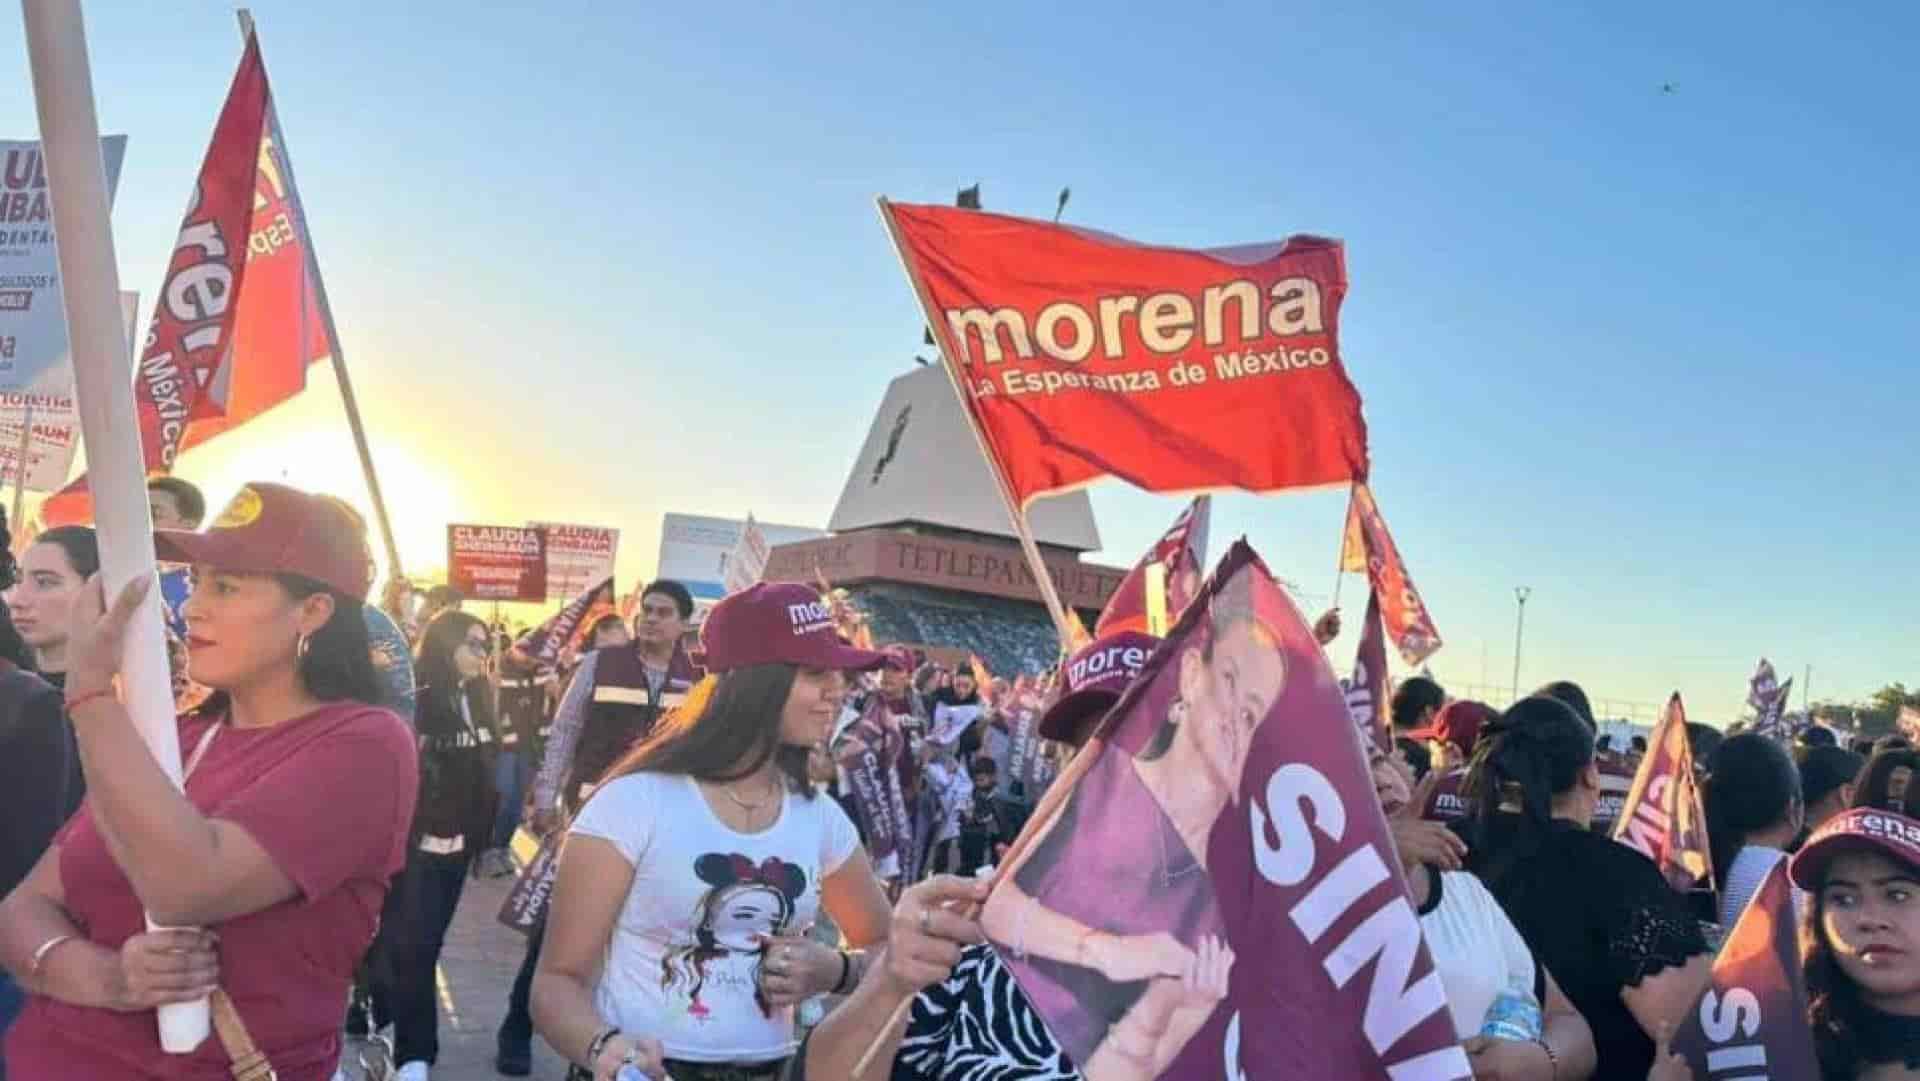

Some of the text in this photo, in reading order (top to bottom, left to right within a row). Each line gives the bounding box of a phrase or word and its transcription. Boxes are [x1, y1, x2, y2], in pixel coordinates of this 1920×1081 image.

[946, 274, 1328, 364] morena
[968, 345, 1330, 399] La Esperanza de México
[453, 526, 539, 543] CLAUDIA
[1068, 646, 1154, 688] more
[1828, 814, 1920, 842] orena
[1700, 987, 1768, 1081] SI
